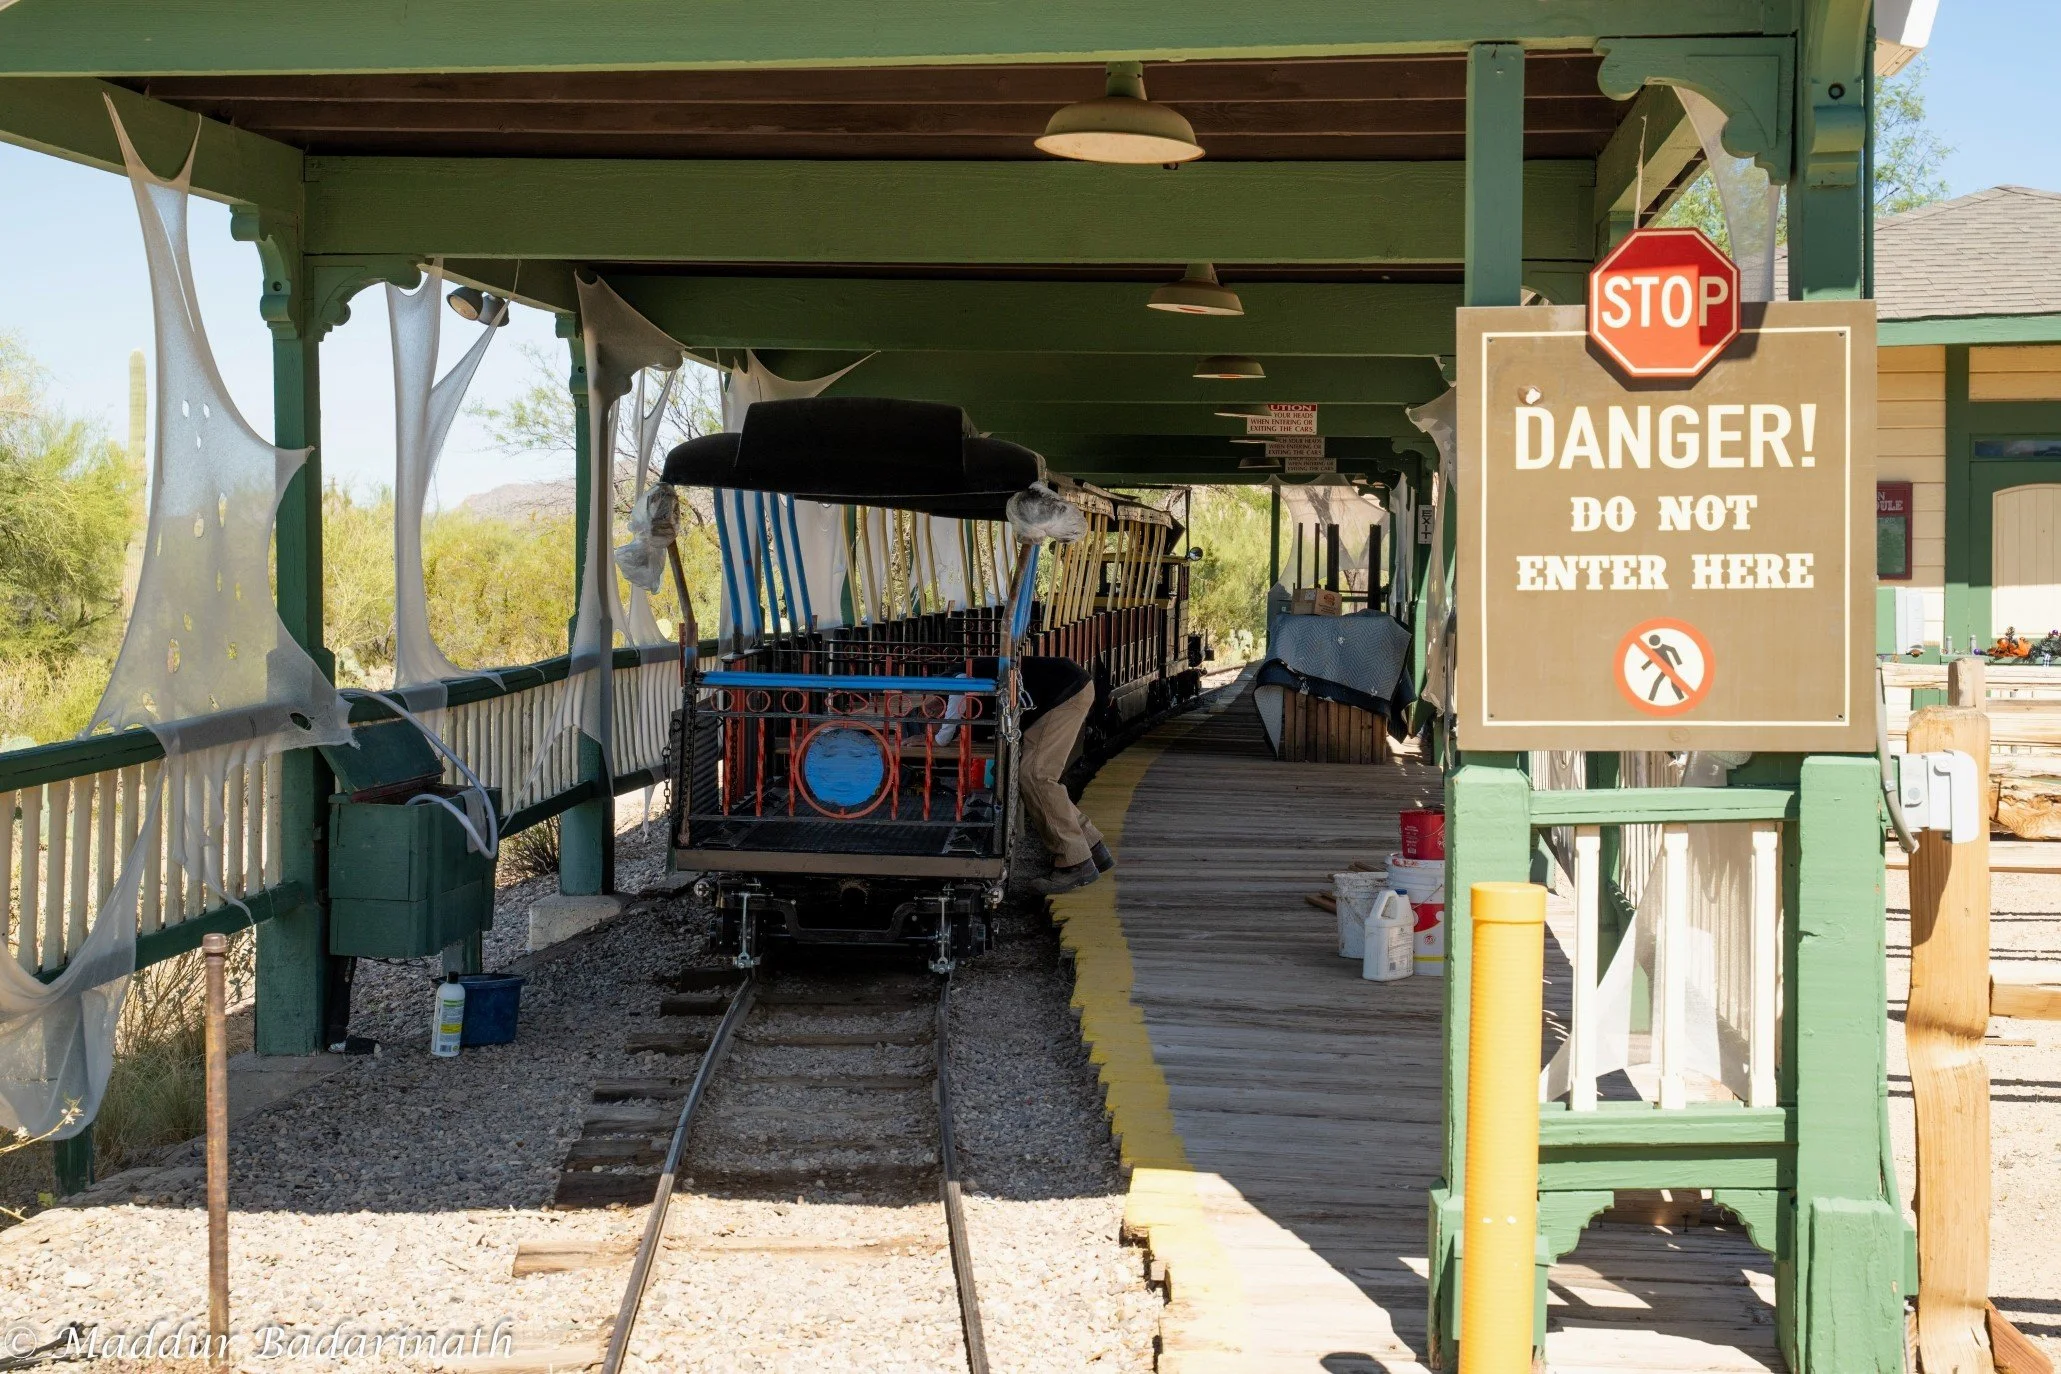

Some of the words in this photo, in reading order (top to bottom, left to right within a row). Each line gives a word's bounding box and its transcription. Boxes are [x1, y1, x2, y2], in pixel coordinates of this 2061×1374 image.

[1602, 275, 1729, 328] STOP
[1271, 418, 1302, 426] ENTERING
[1515, 403, 1817, 470] DANGER!
[1421, 510, 1433, 540] EXIT
[1570, 495, 1637, 533] DO
[1658, 494, 1758, 531] NOT
[1515, 554, 1669, 592] ENTER
[1691, 553, 1815, 590] HERE
